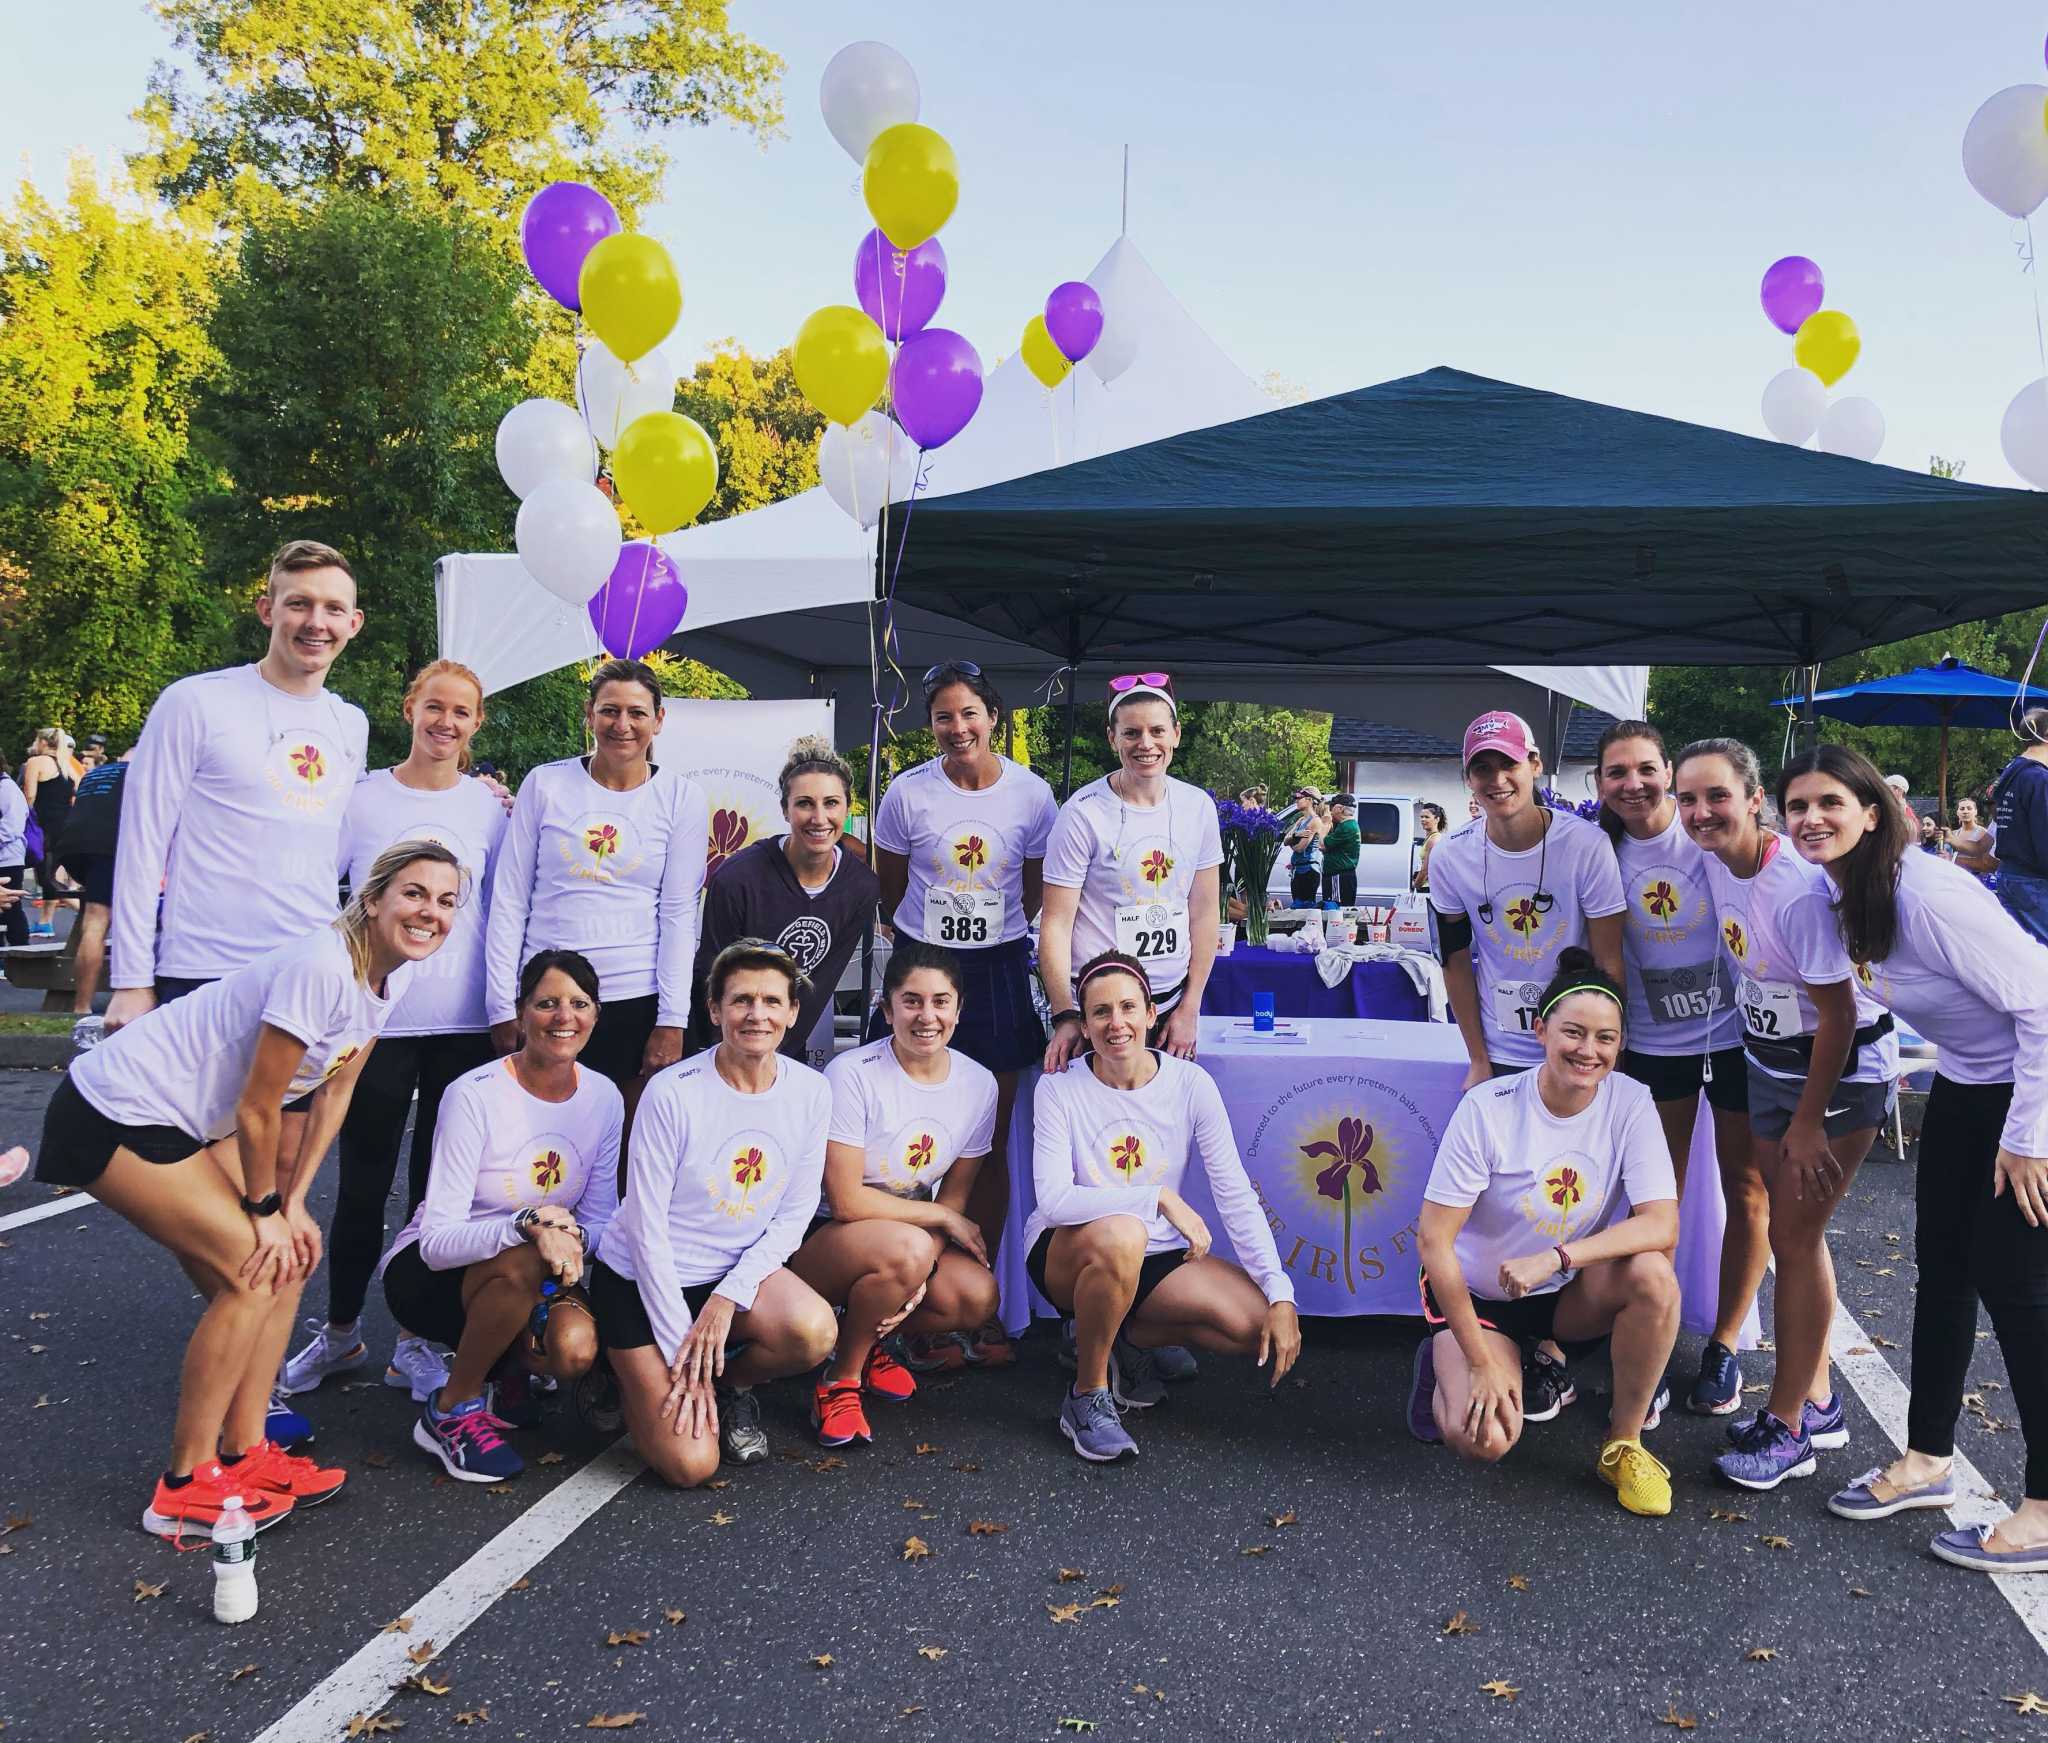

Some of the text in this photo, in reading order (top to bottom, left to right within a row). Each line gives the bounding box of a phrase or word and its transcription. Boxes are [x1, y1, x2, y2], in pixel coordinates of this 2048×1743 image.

[702, 768, 730, 778] every
[733, 769, 774, 790] preterm
[940, 915, 987, 942] 383
[1121, 915, 1140, 923] HALF
[1135, 928, 1177, 958] 229
[1497, 988, 1514, 996] HALF
[1660, 987, 1726, 1018] 1052
[1255, 1010, 1273, 1018] body
[1514, 1007, 1540, 1031] 17
[1744, 1003, 1781, 1036] 152
[678, 1069, 696, 1079] CRAFT
[1494, 1088, 1515, 1098] CRAFT
[1246, 1114, 1270, 1158] Devoted
[1268, 1105, 1279, 1116] to
[1278, 1091, 1294, 1106] the
[1292, 1077, 1324, 1095] future
[1326, 1074, 1355, 1085] every
[1357, 1076, 1399, 1098] preterm
[1399, 1093, 1420, 1115] baby
